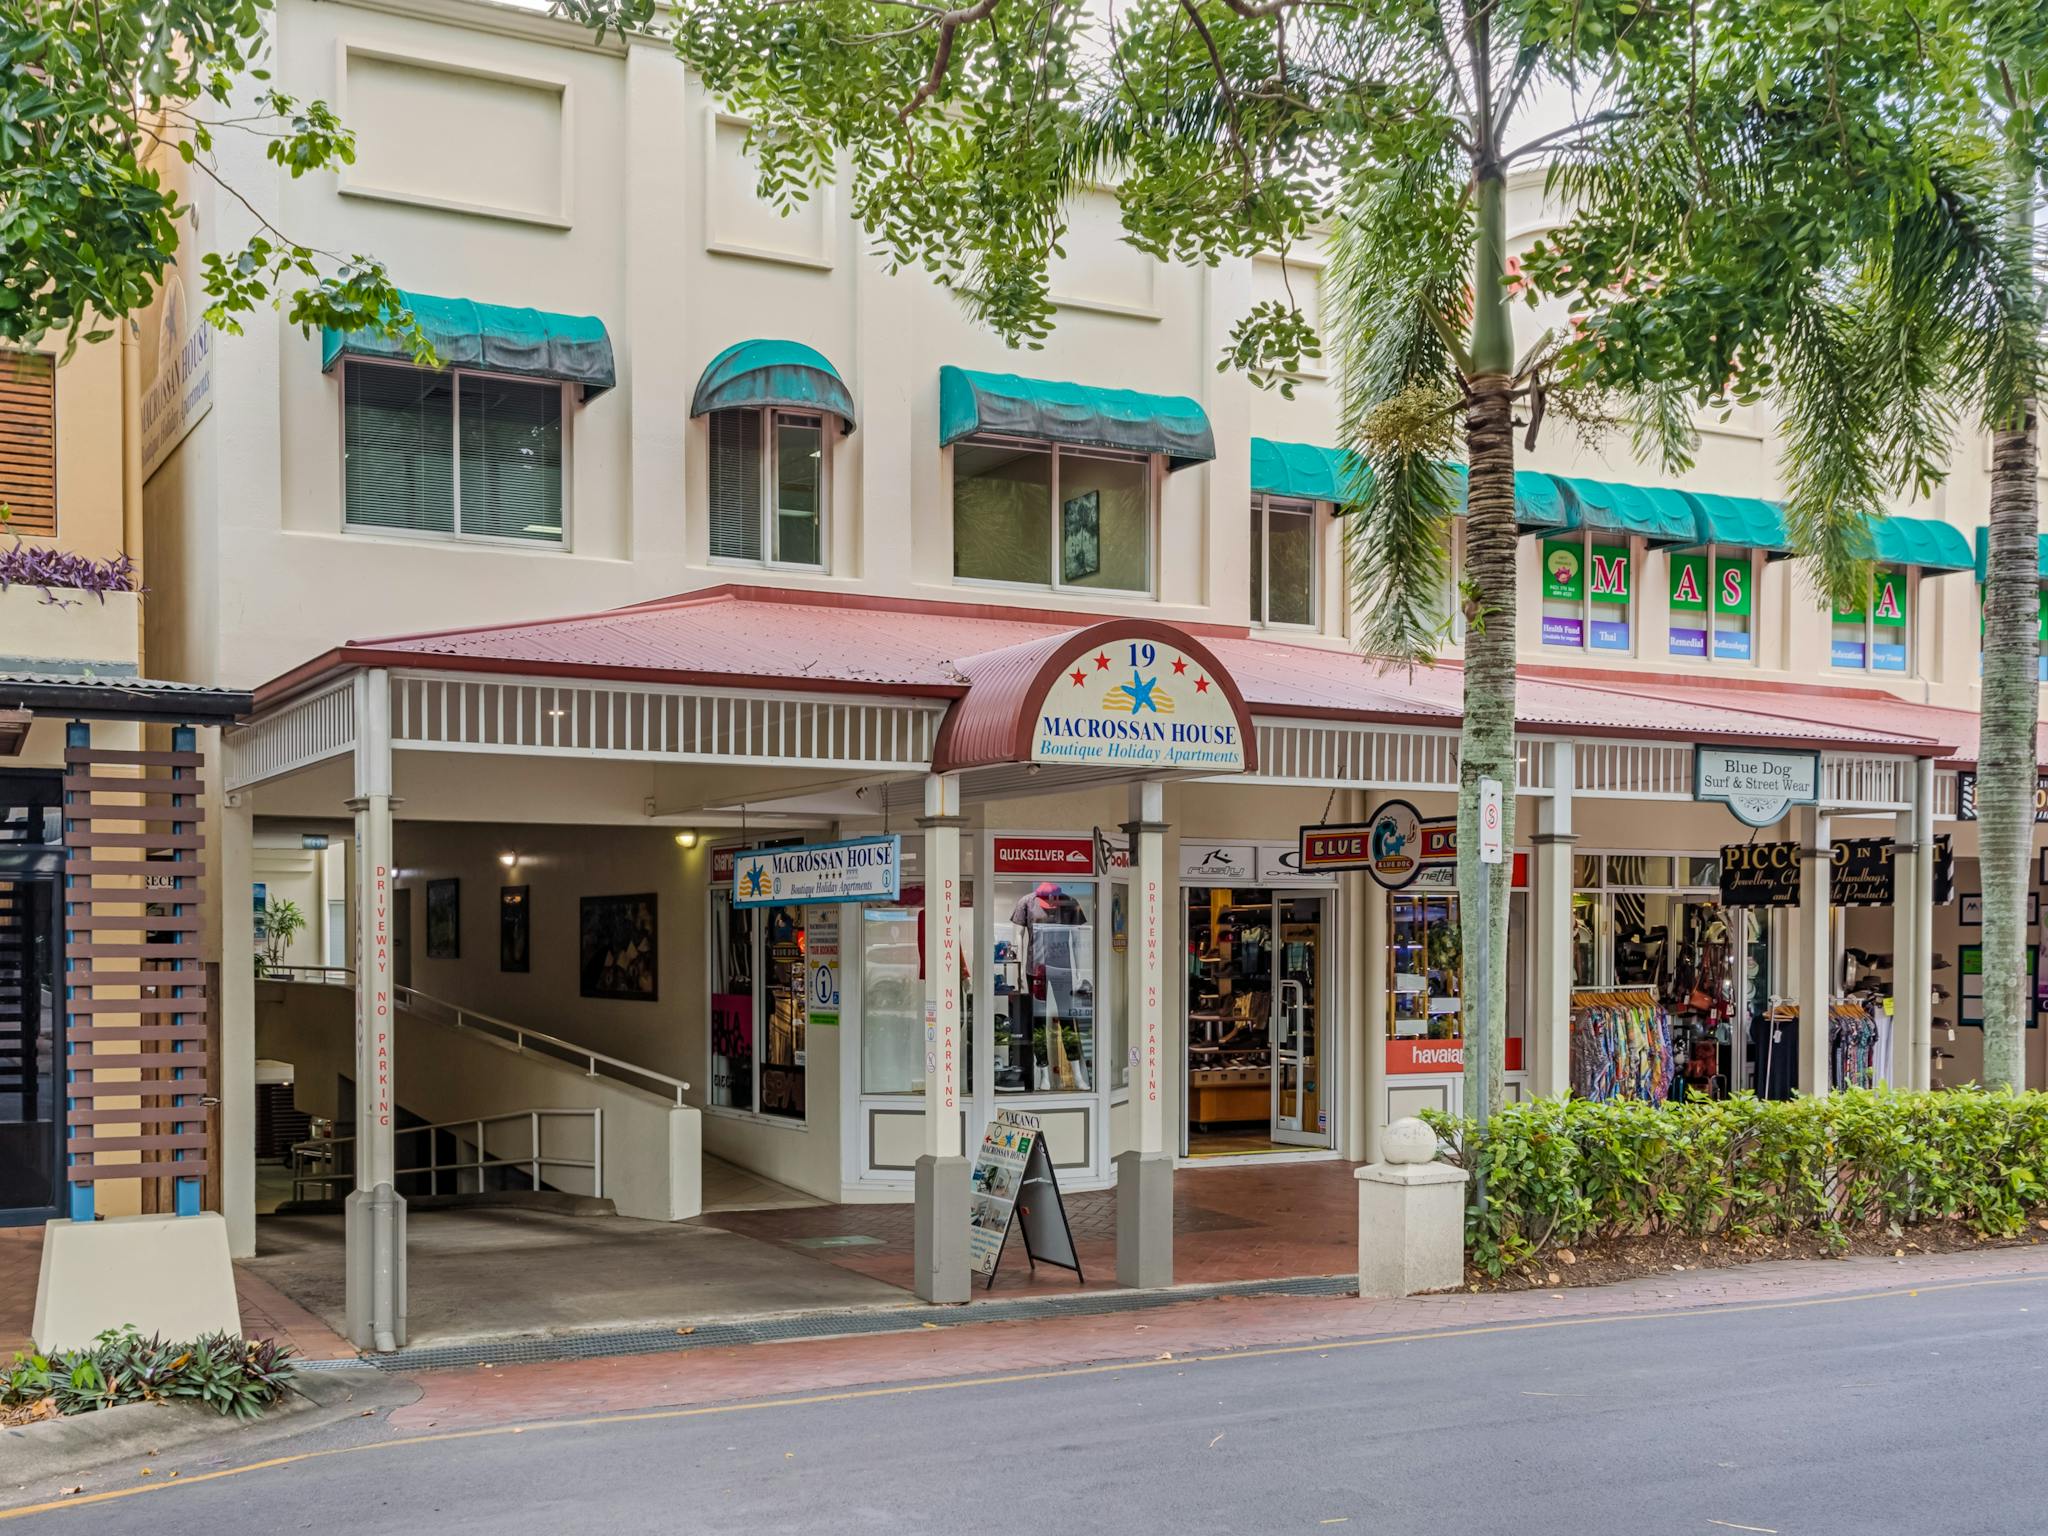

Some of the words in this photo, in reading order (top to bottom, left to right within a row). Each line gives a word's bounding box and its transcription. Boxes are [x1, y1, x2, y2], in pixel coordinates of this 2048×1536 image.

[182, 320, 208, 384] HOUSE
[1543, 624, 1563, 633] Health
[1564, 625, 1580, 635] Fund
[1599, 631, 1617, 642] Thai
[1670, 637, 1704, 648] Remedial
[1128, 643, 1156, 668] 19
[1043, 716, 1165, 742] MACROSSAN
[1171, 723, 1237, 745] HOUSE
[1040, 740, 1103, 759] Boutique
[1107, 743, 1161, 763] Holiday
[1165, 748, 1239, 764] Apartments
[1725, 760, 1758, 774] Blue
[1763, 762, 1792, 779] Dog
[1704, 775, 1730, 788] Surf
[1732, 777, 1742, 789] &
[1746, 777, 1779, 790] Street
[1782, 779, 1810, 792] Wear
[1000, 849, 1064, 862] QUIKSILVER
[1313, 839, 1361, 857] BLUE
[1857, 847, 1872, 858] IN
[772, 850, 843, 875] MACROSSAN
[848, 847, 892, 868] HOUSE
[1187, 866, 1245, 878] rusty
[1730, 870, 1777, 889] Jewellery,
[1835, 866, 1889, 886] Handbags,
[790, 884, 815, 895] Boutique
[816, 881, 838, 894] Holiday
[839, 880, 873, 892] Apartments
[1772, 887, 1791, 901] and
[1844, 883, 1889, 902] Products
[376, 866, 387, 973] DRIVEWAY
[944, 880, 953, 973] DRIVEWAY
[1147, 882, 1157, 970] DRIVEWAY
[377, 992, 387, 1016] NO
[945, 989, 953, 1010] NO
[1149, 987, 1156, 1007] NO
[945, 1026, 953, 1108] PARKING
[378, 1033, 389, 1126] PARKING
[1006, 1111, 1040, 1129] VACANCY
